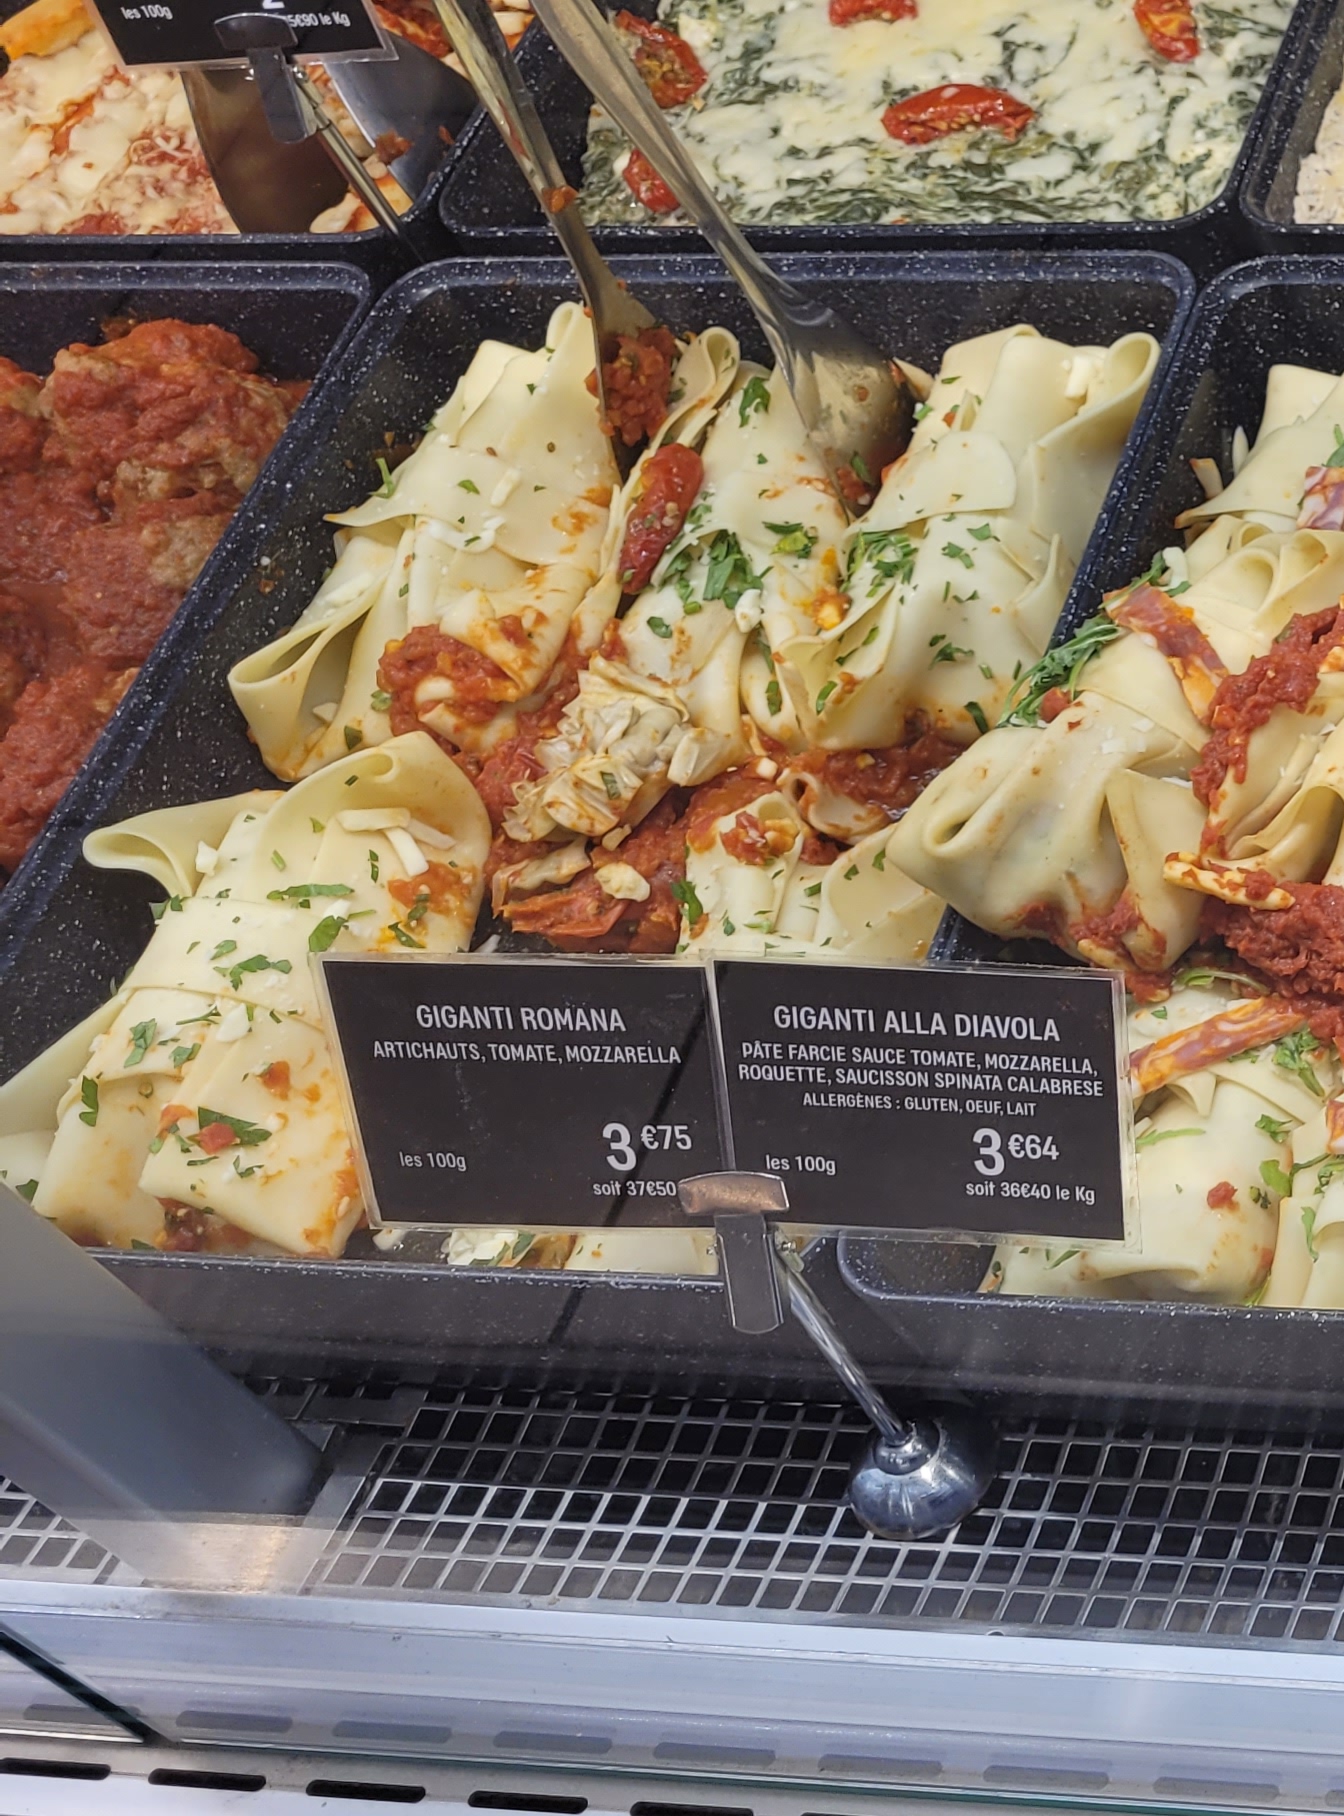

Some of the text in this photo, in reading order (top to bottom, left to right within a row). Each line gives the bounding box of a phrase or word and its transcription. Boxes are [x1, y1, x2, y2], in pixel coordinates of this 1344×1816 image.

[120, 4, 173, 20] les 100g
[287, 11, 351, 27] 5€90 le Kg
[415, 1004, 627, 1033] GIGANTI ROMANA
[773, 1005, 1061, 1042] GIGANTI ALLA DIAVOLA
[373, 1040, 682, 1065] ARTICHAUTS, TOMATE, MOZZARELLA
[741, 1040, 1098, 1077] PÂTE FARCIE SAUCE TOMATE, MOZZARELLA,
[738, 1064, 1104, 1097] ROQUETTE, SAUCISSON SPINATA CALABRESE
[802, 1091, 893, 1110] ALLERGÈNES
[904, 1096, 963, 1115] GLUTEN,
[965, 1100, 1004, 1117] OEUF,
[1006, 1101, 1037, 1117] LAIT
[602, 1122, 693, 1172] 3 €75
[972, 1127, 1060, 1176] 3 €64
[399, 1151, 467, 1172] les 100g
[765, 1154, 836, 1175] les 100g
[593, 1180, 677, 1197] soit 37€50
[965, 1180, 1095, 1205] soit 36€40 le Kg
